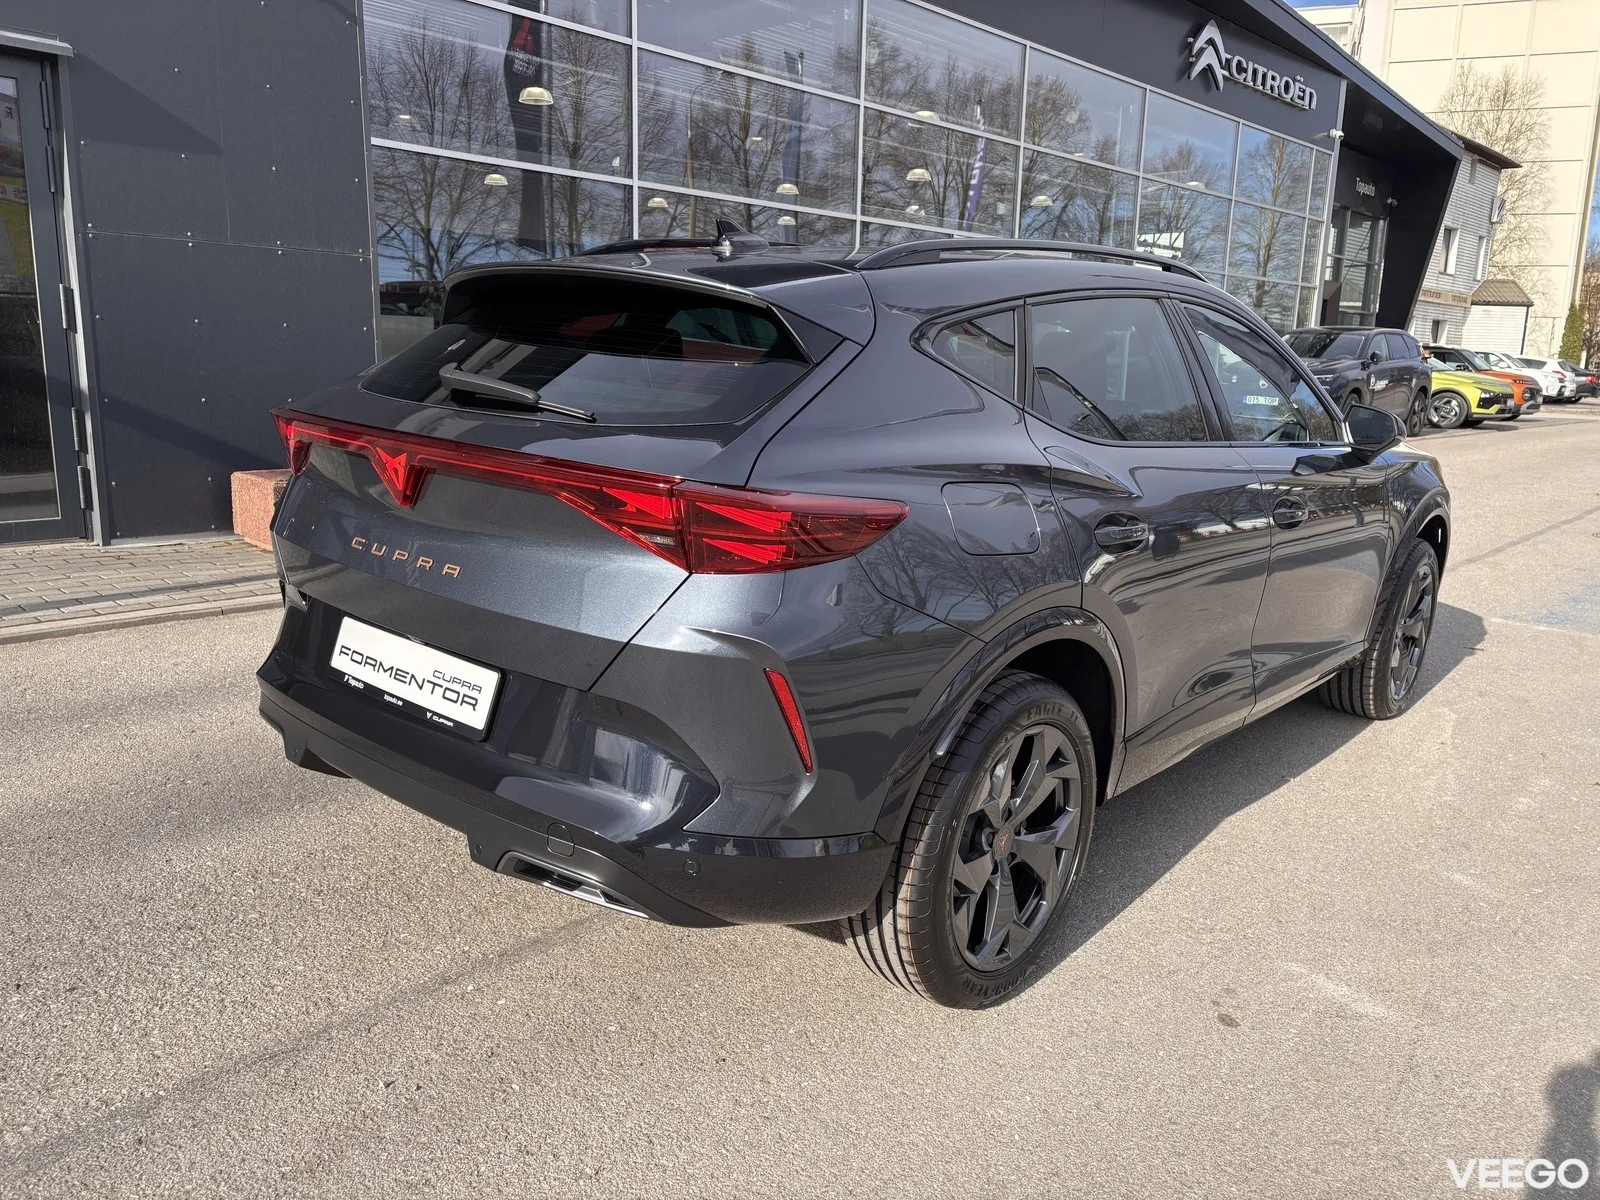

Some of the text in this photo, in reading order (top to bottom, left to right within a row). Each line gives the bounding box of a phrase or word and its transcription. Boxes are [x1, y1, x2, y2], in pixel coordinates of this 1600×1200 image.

[1230, 54, 1318, 110] CITROËN
[1355, 177, 1376, 197] Topauto
[351, 536, 461, 579] CUPRA
[338, 644, 479, 712] FORMENTOR
[432, 669, 483, 695] CUPRA
[432, 714, 454, 727] CUPRA
